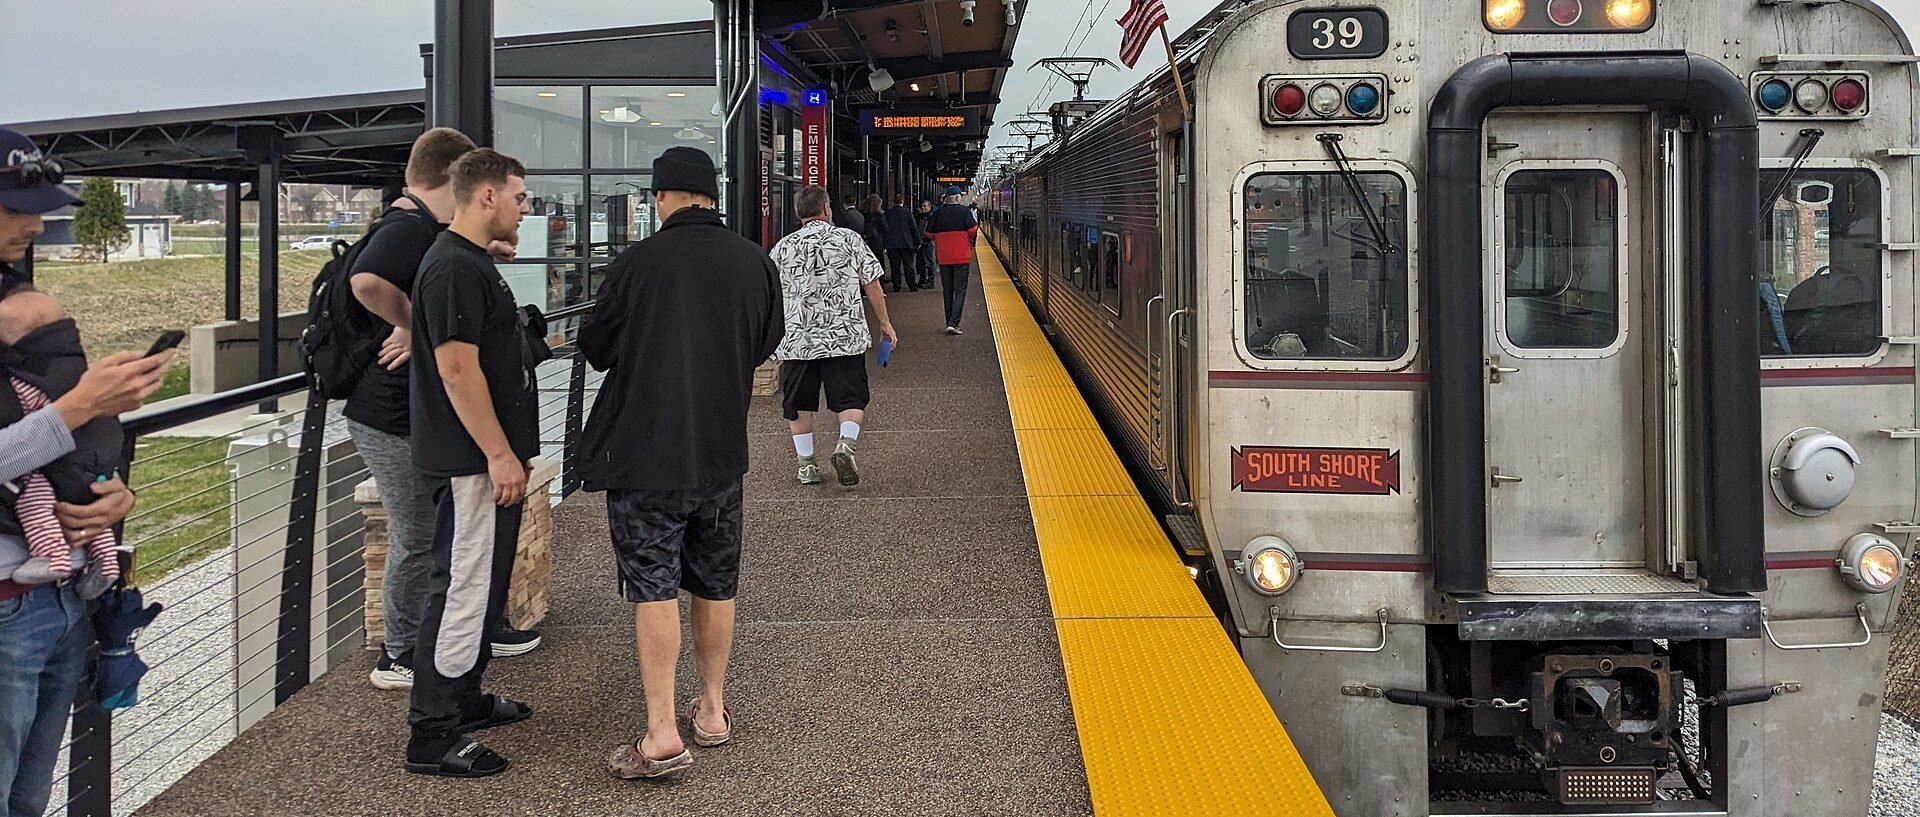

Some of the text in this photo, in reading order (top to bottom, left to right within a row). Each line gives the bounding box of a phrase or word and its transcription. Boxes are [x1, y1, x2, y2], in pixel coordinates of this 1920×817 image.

[1312, 17, 1363, 49] 39
[1248, 452, 1383, 487] SOUTH SHORE
[1288, 474, 1341, 488] LINE
